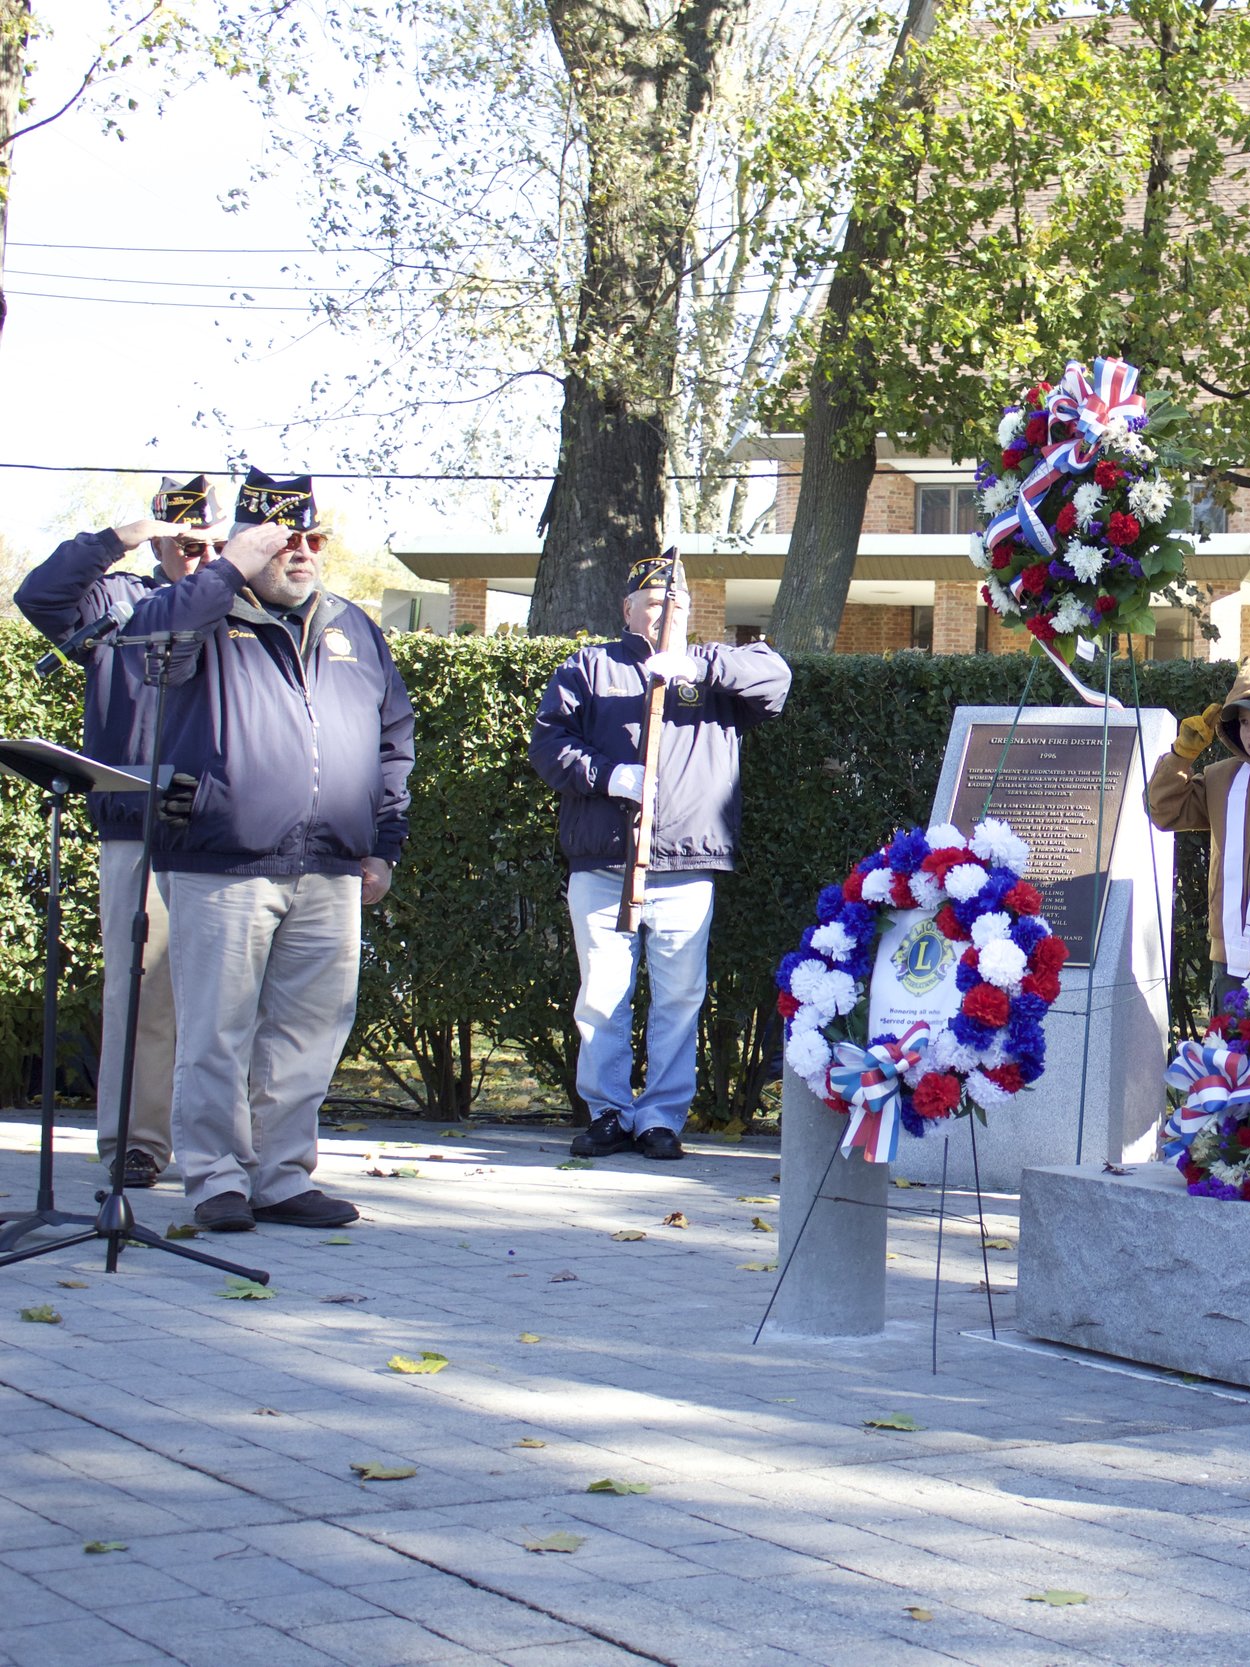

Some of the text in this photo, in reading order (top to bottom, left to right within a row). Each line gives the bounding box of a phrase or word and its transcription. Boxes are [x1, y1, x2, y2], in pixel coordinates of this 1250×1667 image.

[277, 518, 296, 527] 1244
[1040, 752, 1057, 760] 1996
[915, 941, 931, 969] L
